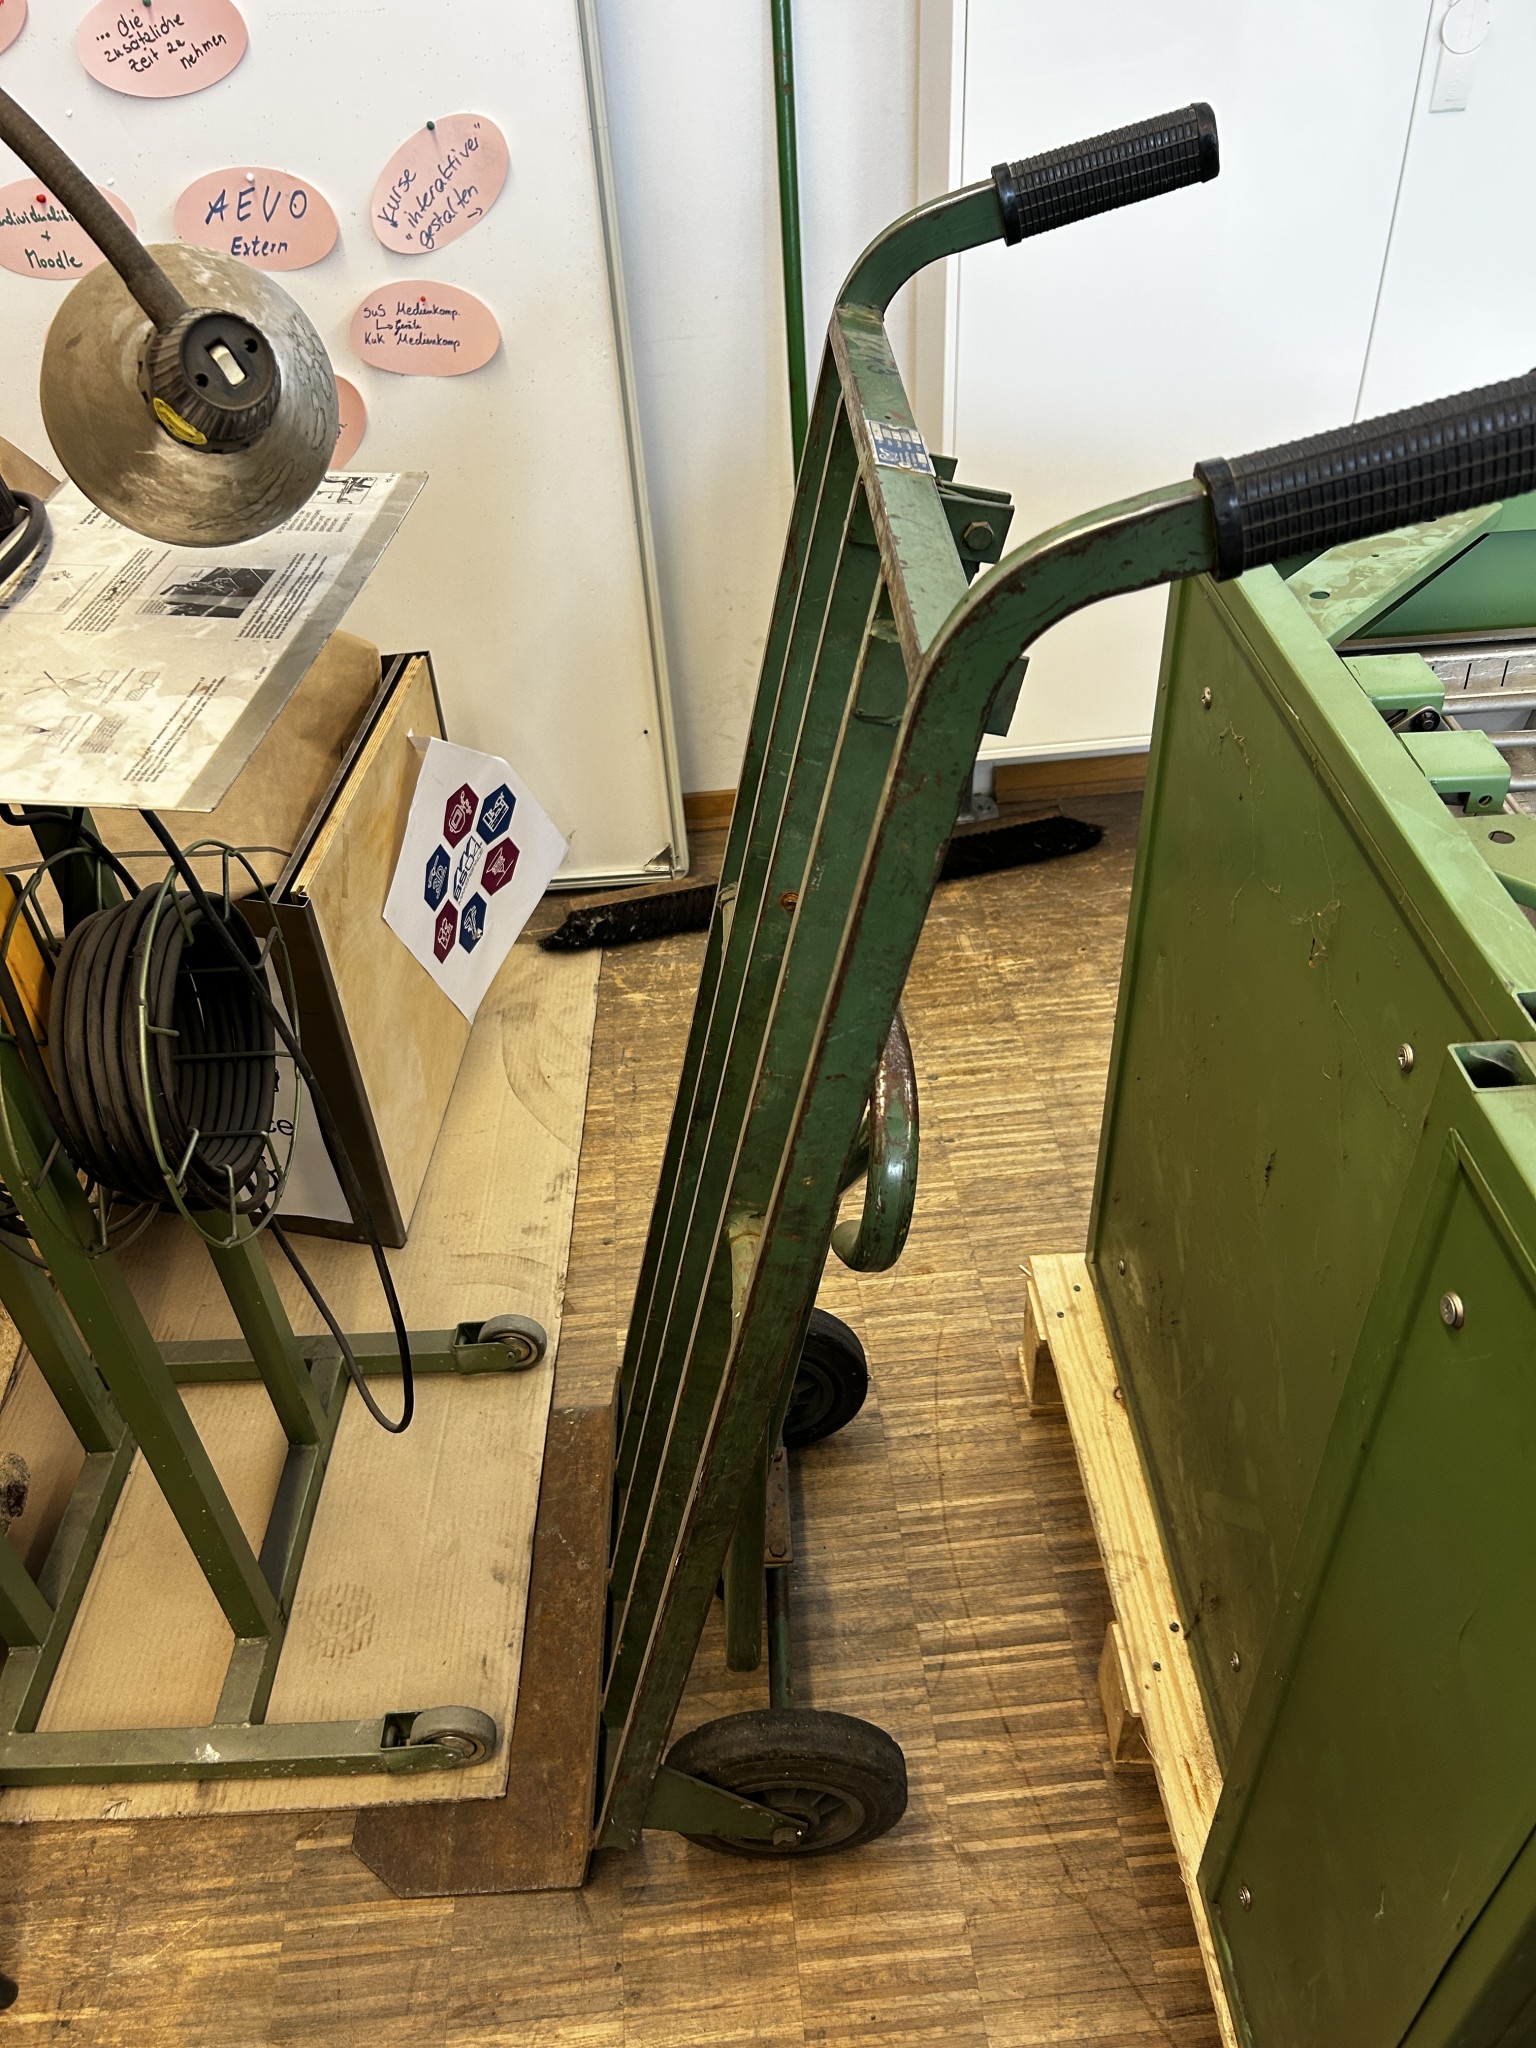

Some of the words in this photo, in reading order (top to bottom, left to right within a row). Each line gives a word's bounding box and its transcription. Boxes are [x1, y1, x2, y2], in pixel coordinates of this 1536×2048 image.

[117, 9, 143, 38] die
[180, 33, 227, 70] nehmen
[204, 185, 308, 225] AEVO
[420, 185, 479, 249] gestalten
[24, 248, 83, 270] Moodle
[230, 235, 288, 257] Extern
